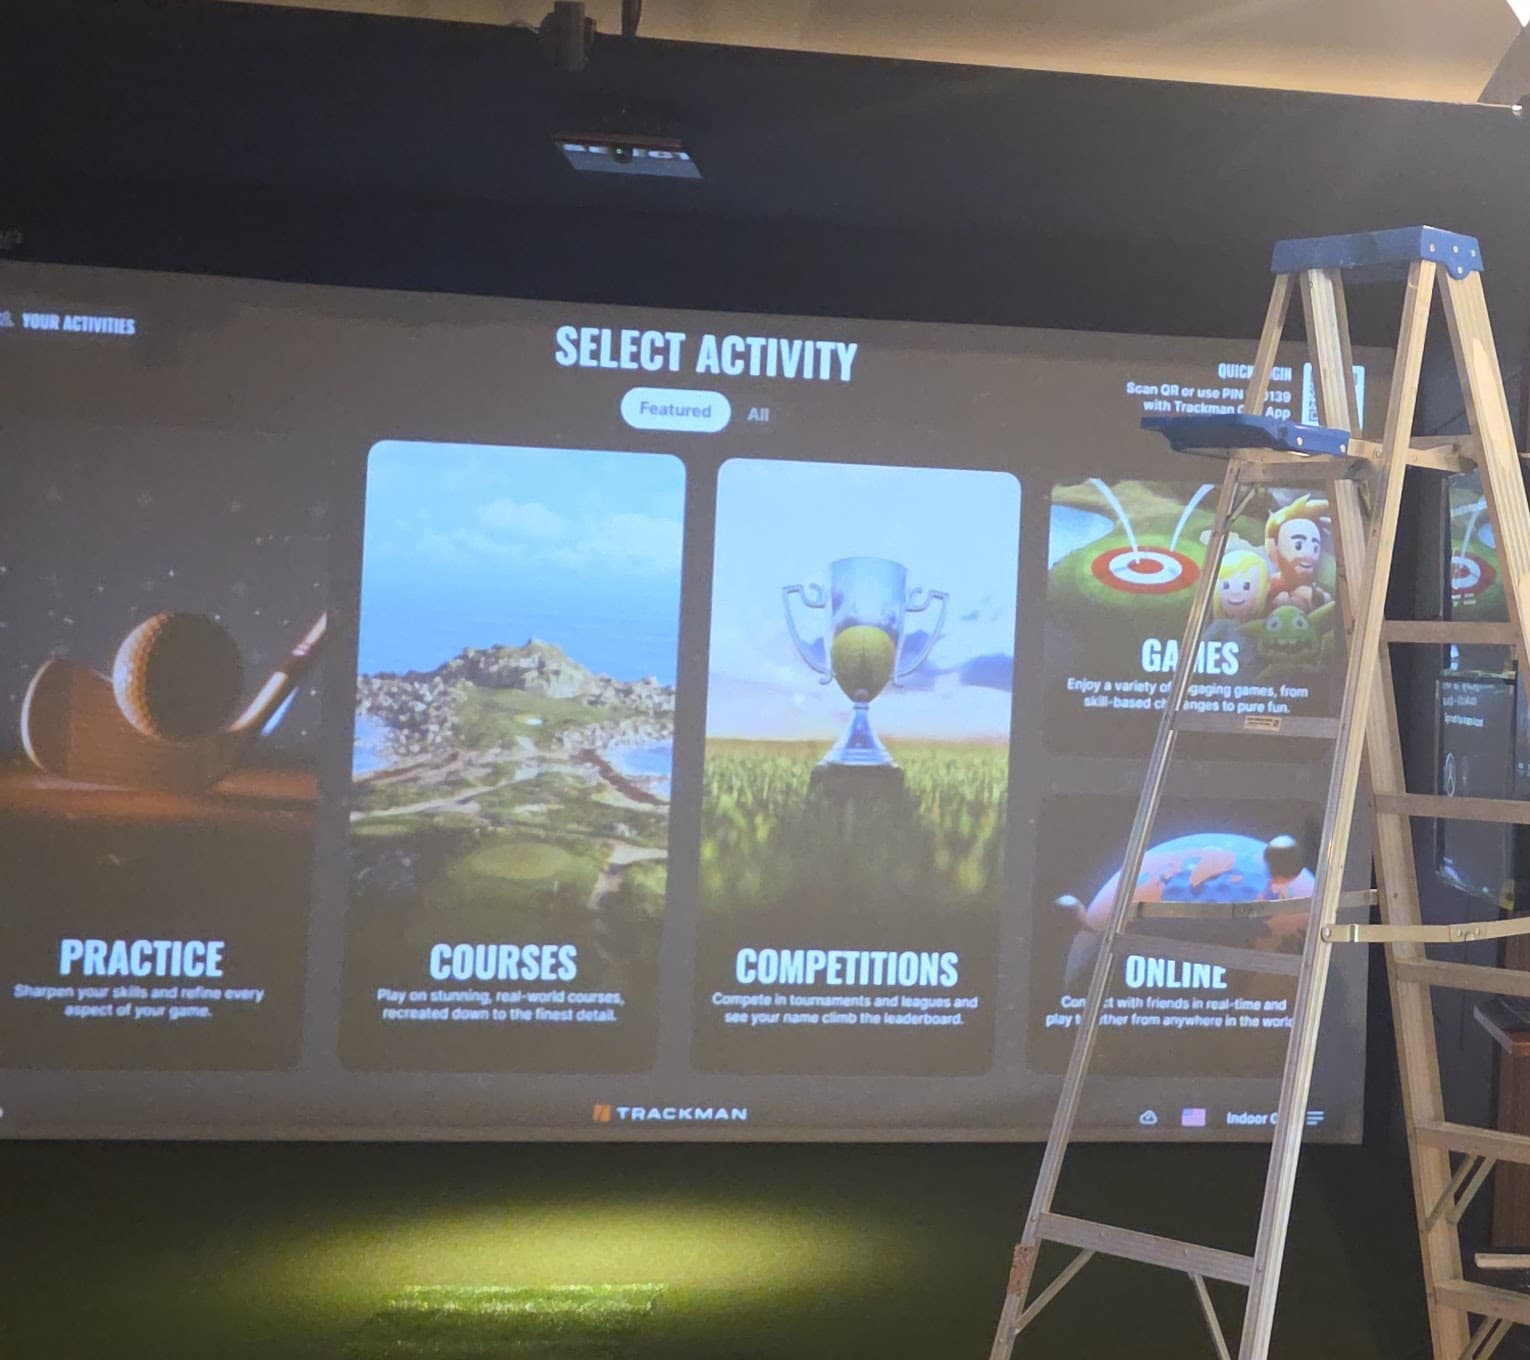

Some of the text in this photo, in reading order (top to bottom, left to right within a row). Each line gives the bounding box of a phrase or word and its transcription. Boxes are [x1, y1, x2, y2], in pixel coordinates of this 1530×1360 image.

[22, 312, 136, 335] YOUR ACTIVITIES
[555, 325, 858, 382] SELECT ACTIVITY
[1126, 381, 1158, 396] Scan
[1160, 384, 1179, 396] QR
[1181, 387, 1195, 397] or
[1197, 388, 1220, 400] use
[1222, 388, 1244, 399] PIN
[639, 401, 770, 422] Featured All
[1143, 399, 1171, 411] with
[1173, 400, 1235, 415] Trackman
[1265, 406, 1291, 420] App
[1067, 678, 1101, 693] Enjoy
[1104, 682, 1111, 691] a
[1115, 680, 1154, 696] variety
[1160, 680, 1172, 692] of
[1234, 685, 1278, 699] games,
[1279, 685, 1309, 698] from
[1084, 696, 1151, 709] skill-based
[1222, 700, 1235, 712] to
[1237, 701, 1265, 714] pure
[1267, 700, 1290, 714] fun.
[59, 939, 225, 977] PRACTICE
[429, 943, 578, 981] COURSES
[735, 947, 960, 987] COMPETITIONS
[1125, 955, 1228, 989] ONLINE
[13, 984, 264, 1003] Sharpen your skills and refine every
[376, 989, 625, 1006] Play on stunning, real-world courses,
[711, 992, 978, 1011] Compete in tournaments and leagues and
[1117, 996, 1144, 1009] with
[1146, 995, 1190, 1010] friends
[1193, 997, 1204, 1010] in
[1206, 997, 1261, 1011] real-time
[1264, 999, 1287, 1011] and
[64, 1003, 213, 1020] aspect of your game.
[383, 1007, 617, 1022] recreated down to the finest detail.
[724, 1011, 964, 1027] see your name climb the leaderboard.
[1046, 1014, 1072, 1028] play
[1131, 1013, 1160, 1026] from
[1163, 1014, 1222, 1029] anywhere
[1225, 1014, 1237, 1027] in
[1239, 1016, 1260, 1027] the
[616, 1106, 747, 1121] TRACKMAN
[1227, 1111, 1268, 1125] Indoor
